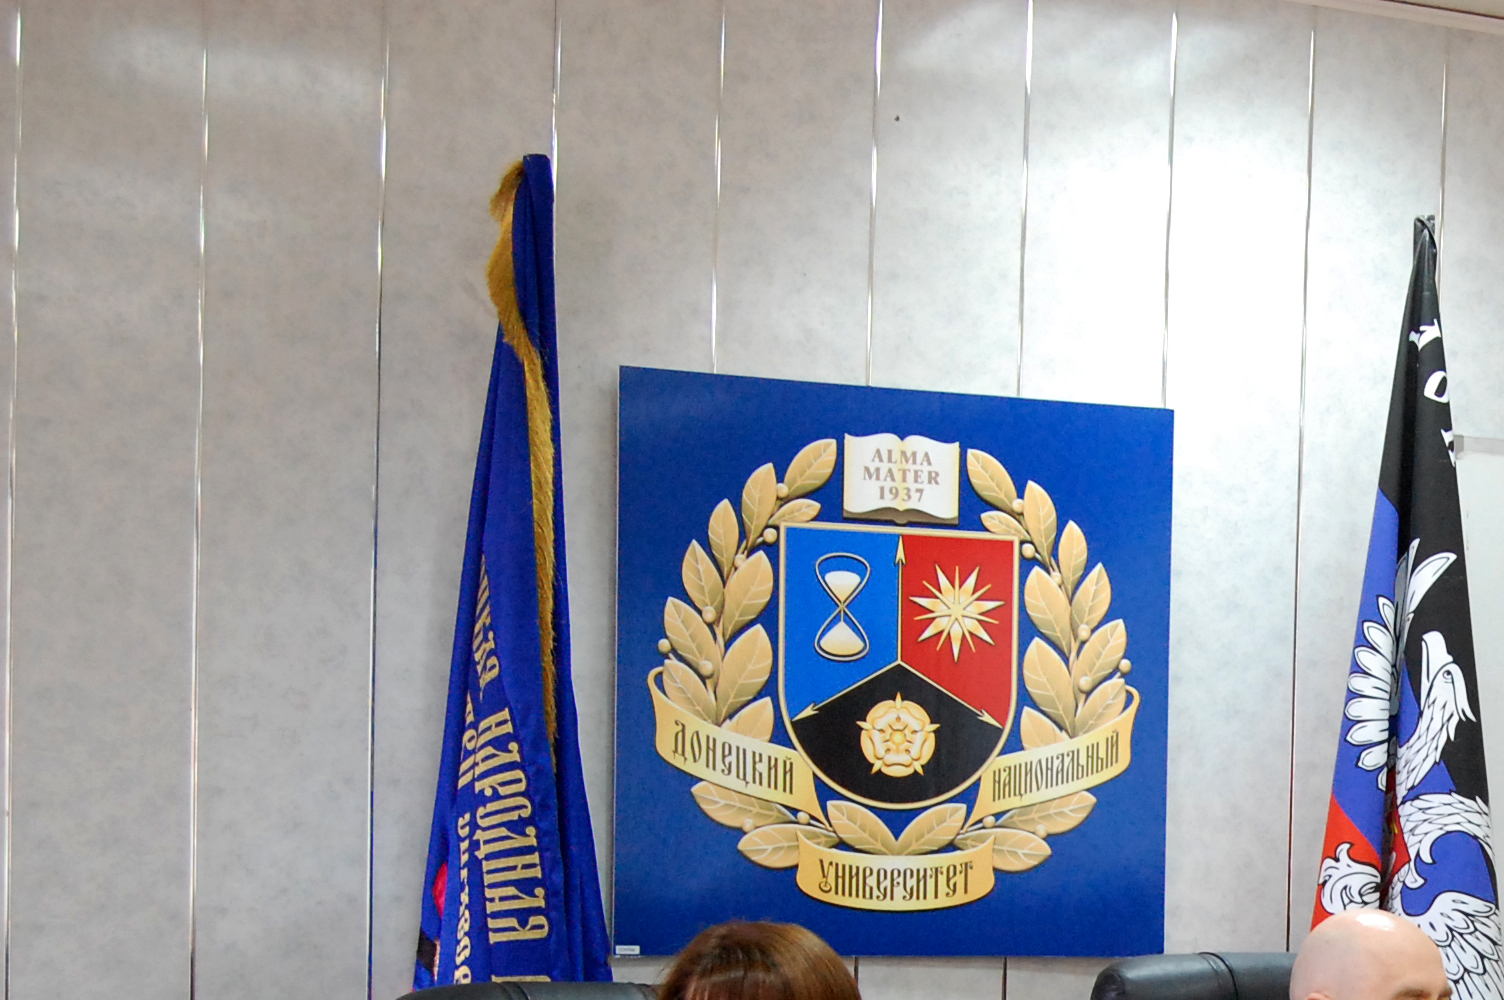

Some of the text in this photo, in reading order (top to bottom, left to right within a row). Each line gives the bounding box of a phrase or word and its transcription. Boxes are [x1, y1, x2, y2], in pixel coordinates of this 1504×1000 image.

[863, 465, 940, 486] MATER
[871, 448, 933, 467] ALMA
[879, 485, 924, 503] 1937
[672, 719, 794, 795] ДОНЕЦКИЙ
[992, 729, 1119, 802] НАЦИОНАЛЬНЫЙ
[475, 707, 549, 944] НАРОДНАЯ
